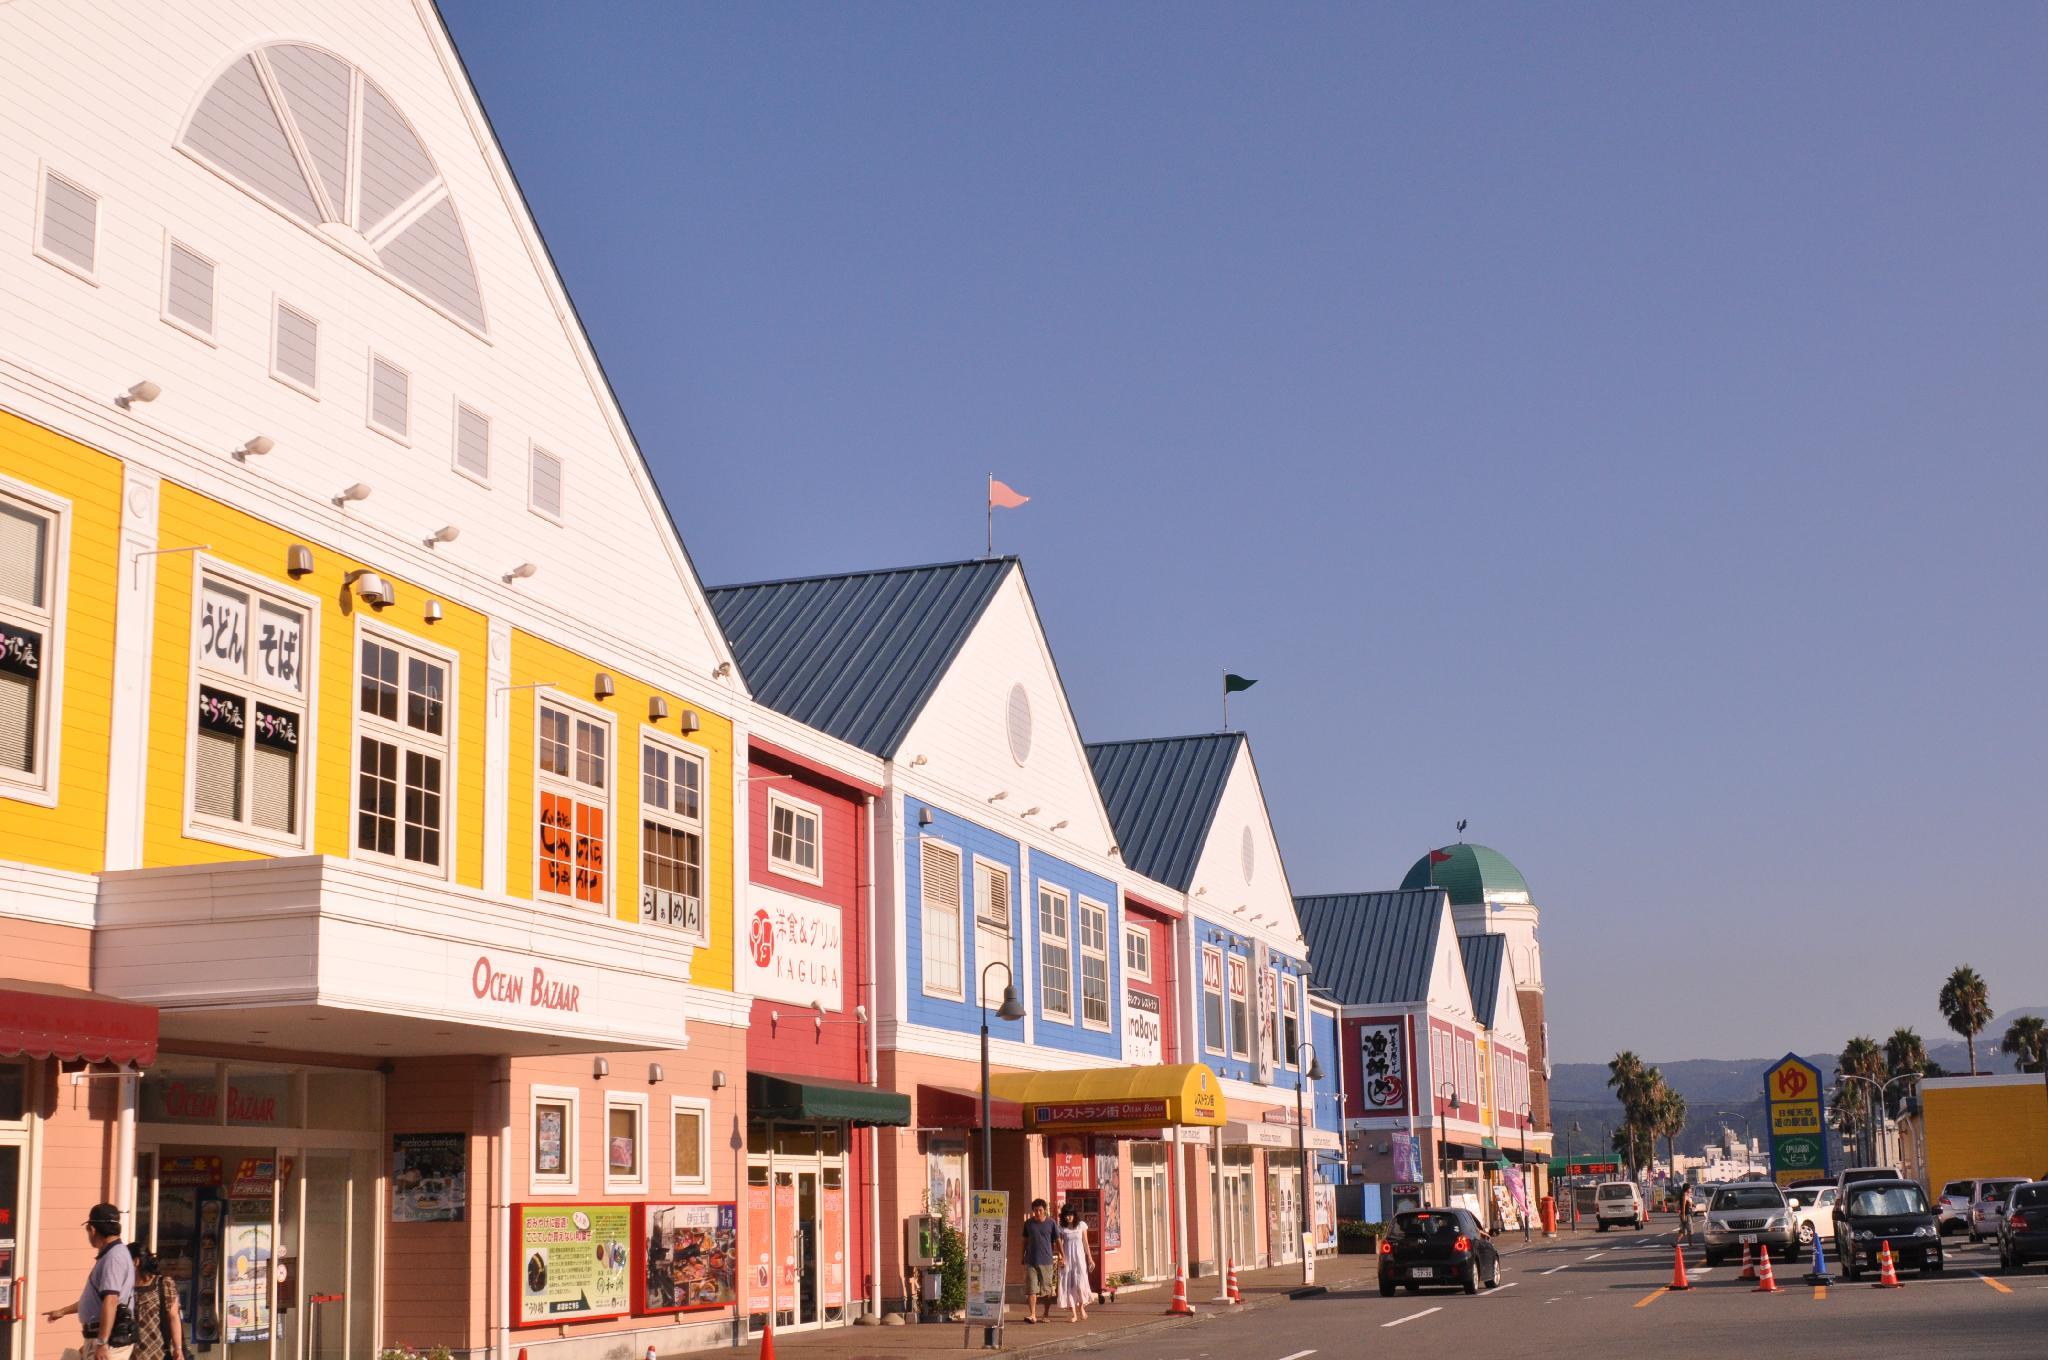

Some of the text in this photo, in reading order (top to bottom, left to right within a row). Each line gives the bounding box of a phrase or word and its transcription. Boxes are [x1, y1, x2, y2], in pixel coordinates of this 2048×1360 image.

[202, 602, 242, 664] うどん
[258, 624, 298, 681] そば
[777, 955, 838, 988] KAGURA
[1053, 1105, 1119, 1119] レストラン街
